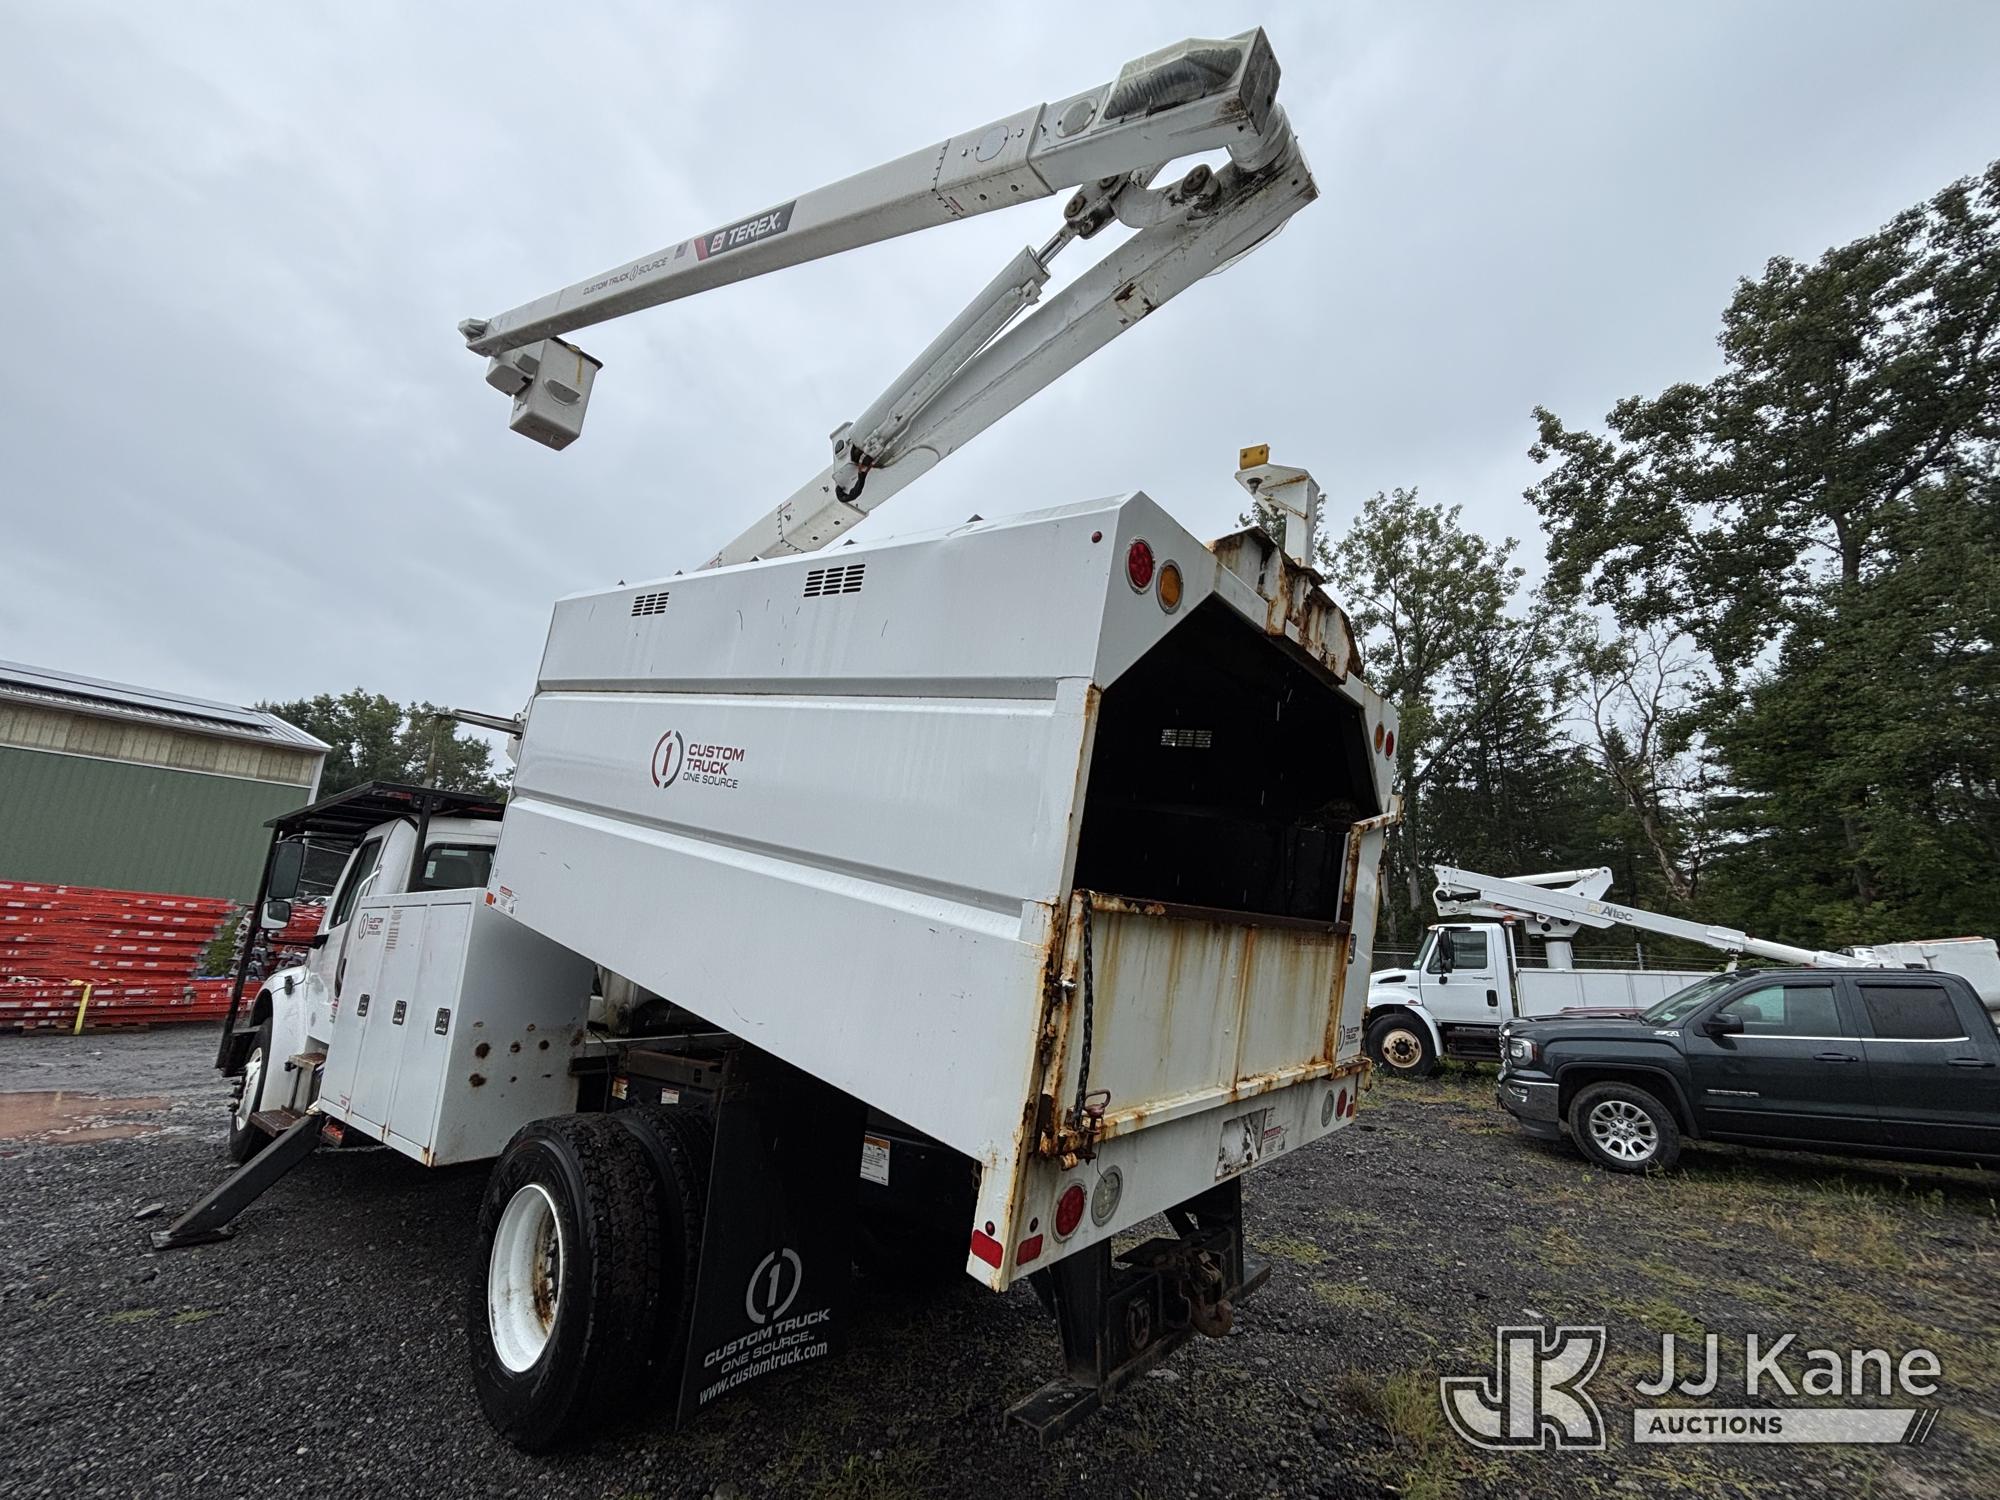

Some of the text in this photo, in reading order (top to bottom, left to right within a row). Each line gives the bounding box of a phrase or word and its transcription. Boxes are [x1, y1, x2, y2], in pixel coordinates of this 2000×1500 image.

[728, 212, 780, 245] TEREX
[583, 280, 608, 295] CUSTOM
[609, 271, 630, 285] TRUCK
[638, 257, 668, 275] SOURCE
[688, 744, 745, 761] CUSTOM
[687, 758, 729, 775] TRUCK
[682, 772, 739, 789] ONE SOURCE
[1600, 905, 1633, 922] Altec
[704, 1308, 831, 1367] CUSTOM TRUCK
[700, 1341, 828, 1405] www.customtruck.com
[720, 1352, 750, 1374] ONE
